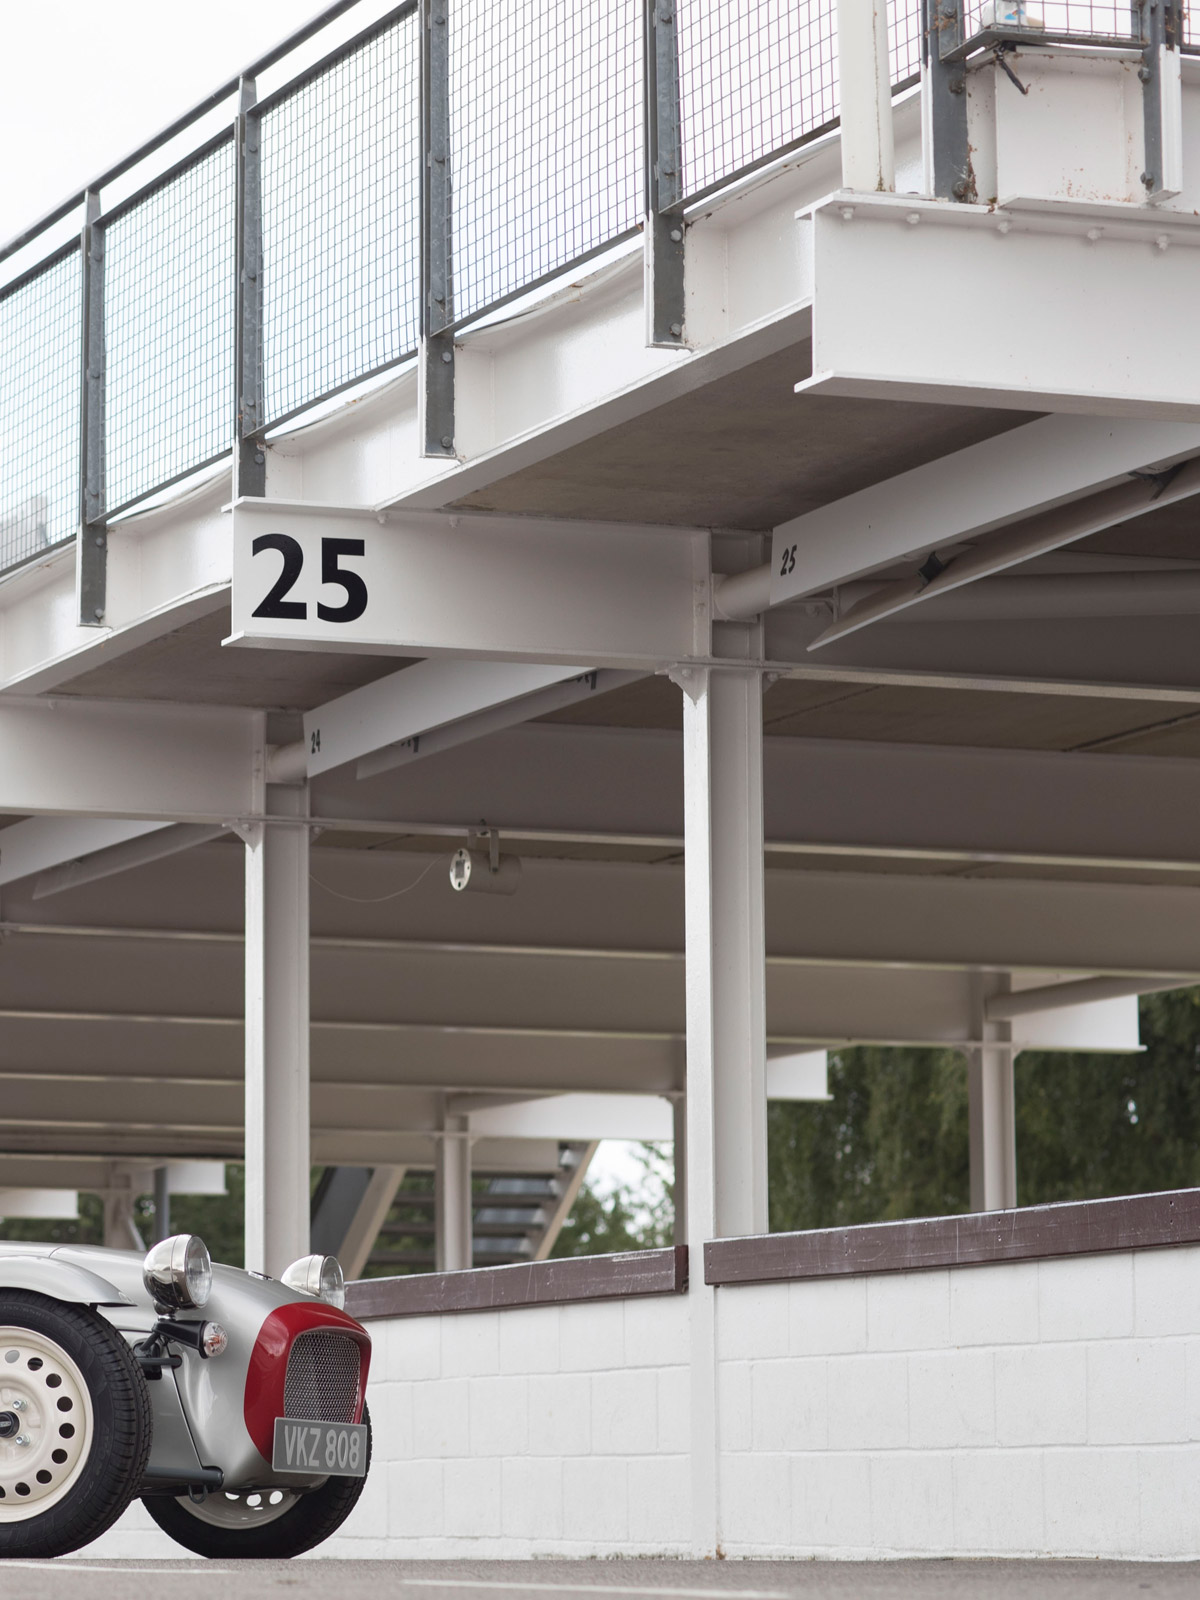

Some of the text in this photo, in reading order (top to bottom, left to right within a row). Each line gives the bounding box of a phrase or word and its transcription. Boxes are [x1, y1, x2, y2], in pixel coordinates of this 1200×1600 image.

[252, 533, 368, 623] 25
[780, 544, 797, 576] 25
[310, 729, 321, 754] 24
[284, 1424, 360, 1469] VKZ 808
